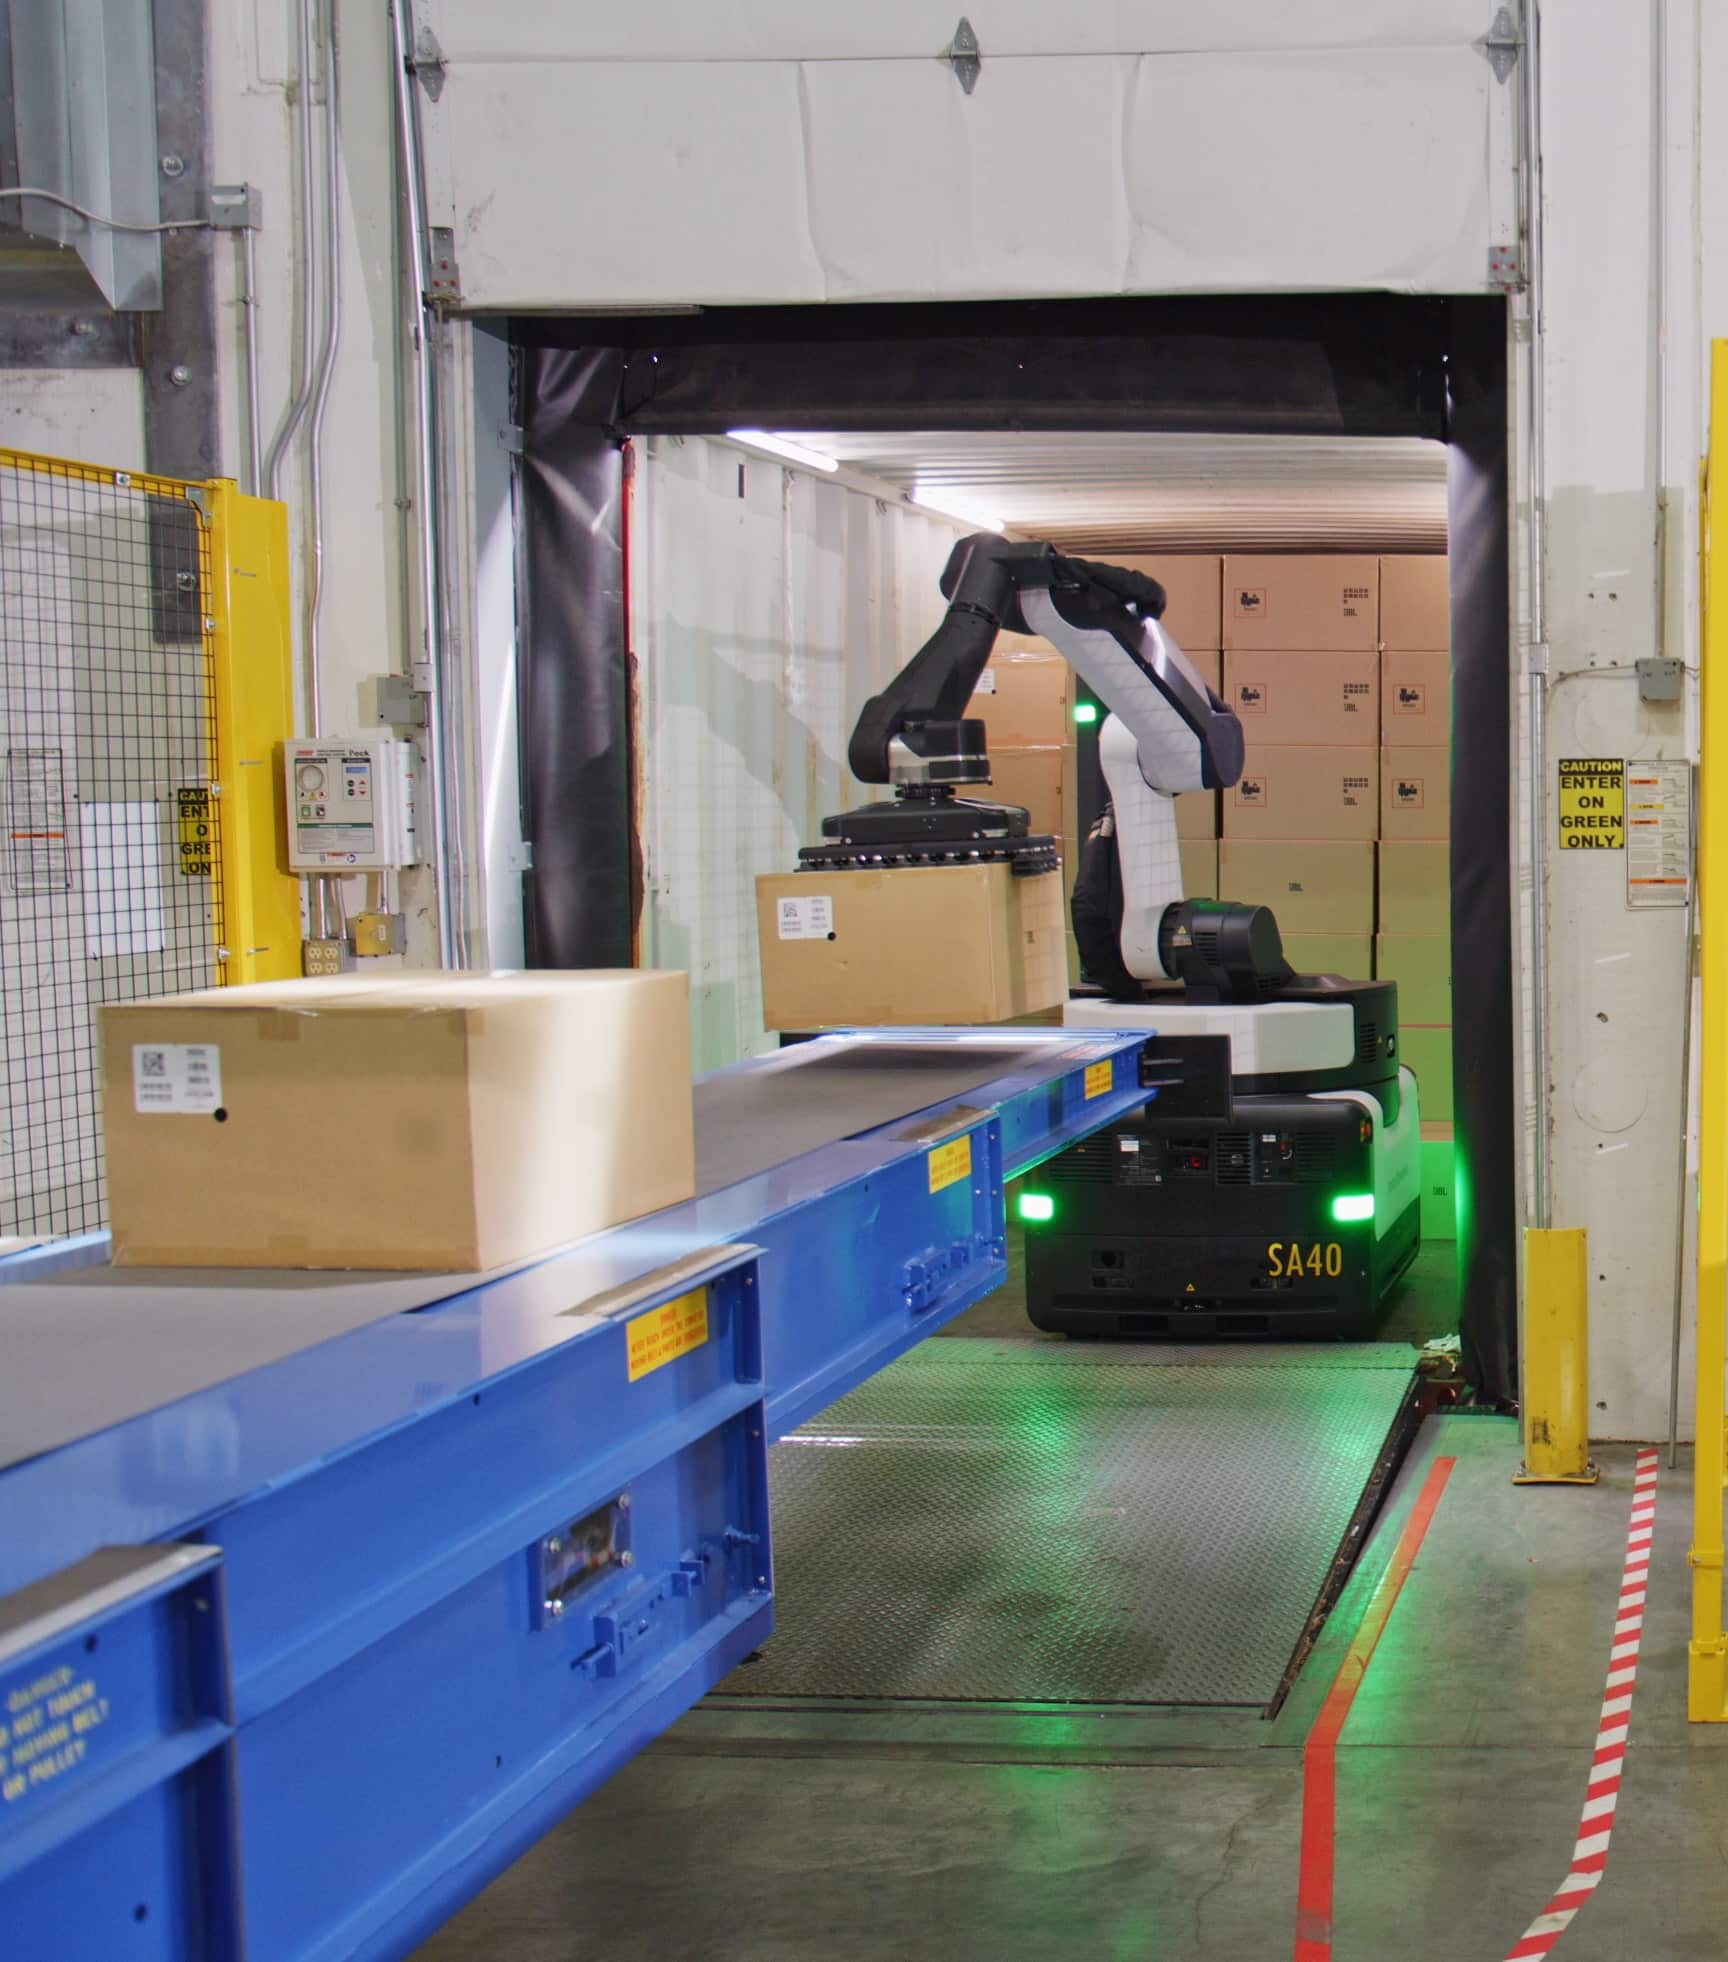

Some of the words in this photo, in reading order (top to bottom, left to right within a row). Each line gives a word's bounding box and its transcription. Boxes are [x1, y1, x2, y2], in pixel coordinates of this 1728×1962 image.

[1560, 761, 1622, 772] CAUTION
[1561, 776, 1621, 789] ENTER
[1578, 796, 1604, 808] ON
[1560, 815, 1622, 828] GREEN
[1567, 835, 1616, 848] ONLY
[1267, 1242, 1342, 1277] SA40
